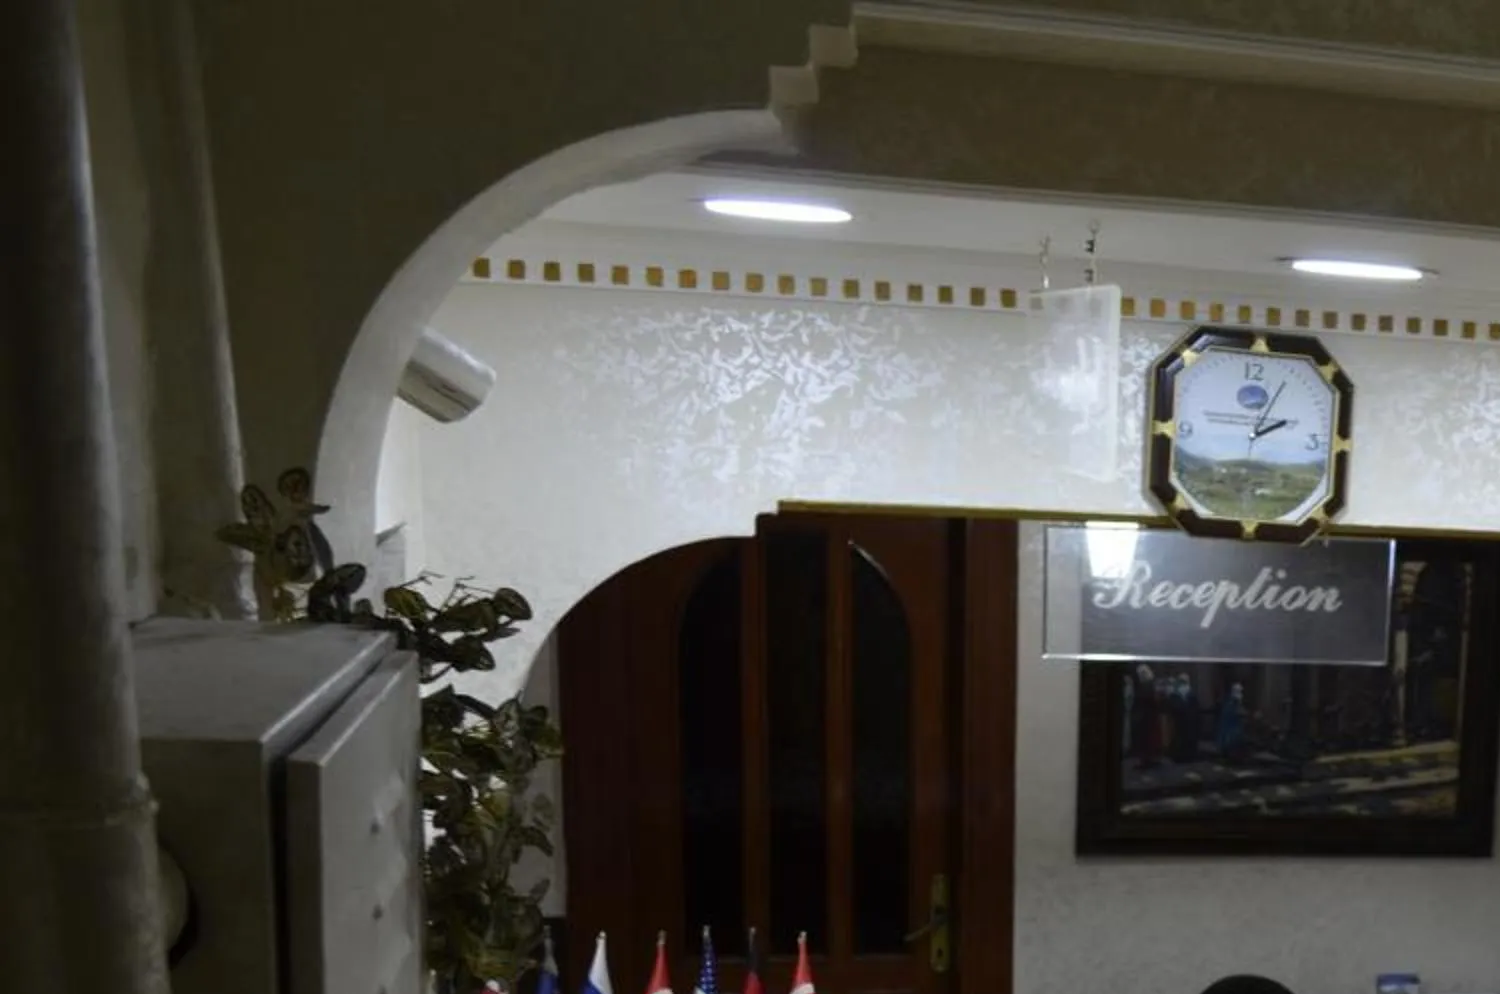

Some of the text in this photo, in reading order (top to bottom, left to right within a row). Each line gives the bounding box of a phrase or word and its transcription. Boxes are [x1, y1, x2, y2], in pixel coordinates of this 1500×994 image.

[1244, 362, 1264, 381] 12
[1179, 420, 1193, 439] 9
[1304, 432, 1320, 451] 3
[1092, 559, 1343, 629] Reception
